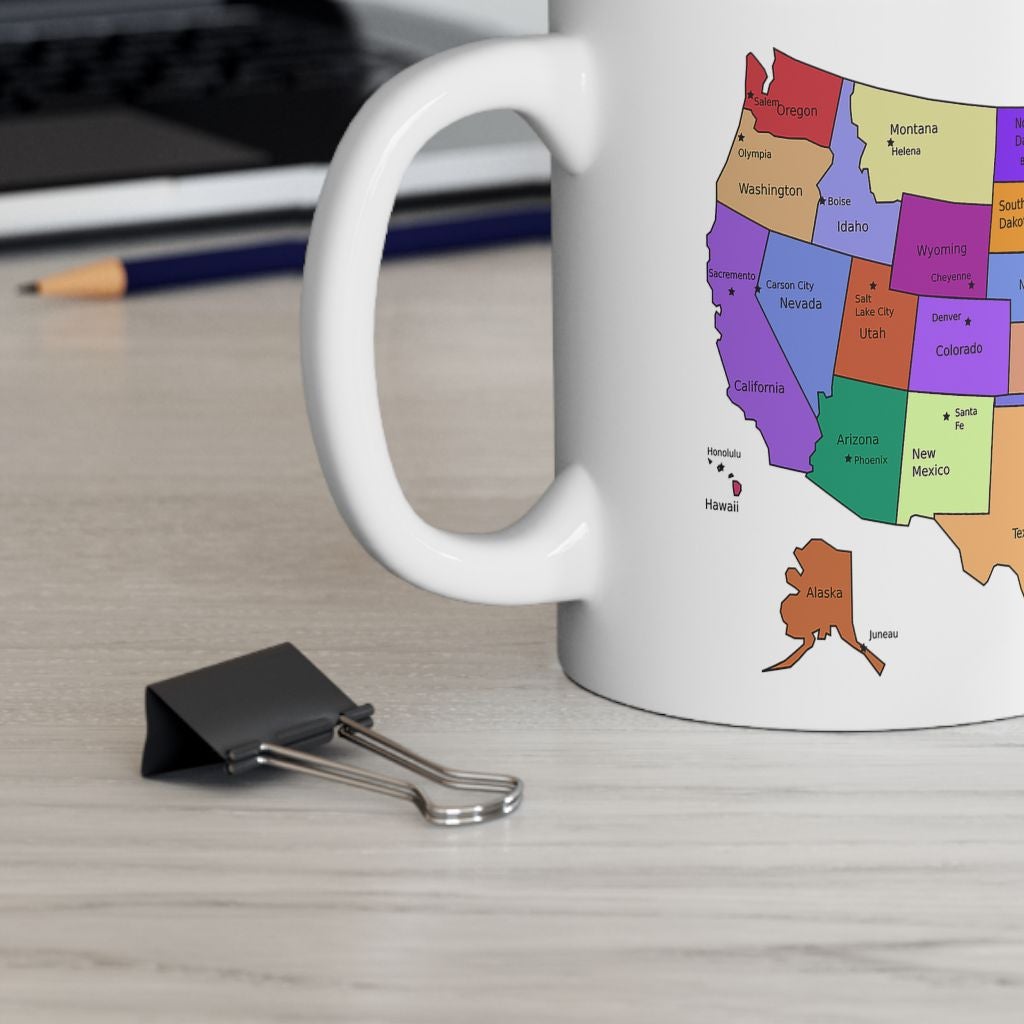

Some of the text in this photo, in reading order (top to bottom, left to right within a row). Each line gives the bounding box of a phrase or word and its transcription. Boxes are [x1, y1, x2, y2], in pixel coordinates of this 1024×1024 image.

[754, 97, 779, 107] Salem
[776, 104, 818, 119] Oregon
[890, 123, 938, 136] Montana
[738, 148, 772, 161] Olympia
[892, 147, 921, 156] Helena
[739, 182, 803, 199] Washington
[828, 196, 851, 206] Boise
[837, 220, 869, 233] Idaho
[916, 242, 967, 259] Wyoming
[708, 268, 756, 281] Sacremento
[931, 272, 972, 284] Cheyenne
[766, 279, 814, 292] Carson City
[780, 297, 822, 310] Nevada
[855, 294, 872, 304] Salt
[855, 307, 894, 318] Lake City
[932, 312, 962, 322] Denver
[860, 327, 886, 340] Utah
[935, 342, 983, 357] Colorado
[734, 379, 785, 394] California
[955, 407, 978, 418] Santa
[955, 421, 965, 430] Fe
[836, 433, 879, 446] Arizona
[707, 446, 742, 459] Honolulu
[912, 448, 936, 460] New
[854, 455, 888, 465] Phoenix
[912, 464, 950, 477] Mexico
[705, 498, 739, 513] Hawaii
[806, 587, 843, 599] Alaska
[868, 629, 899, 641] Juneau
